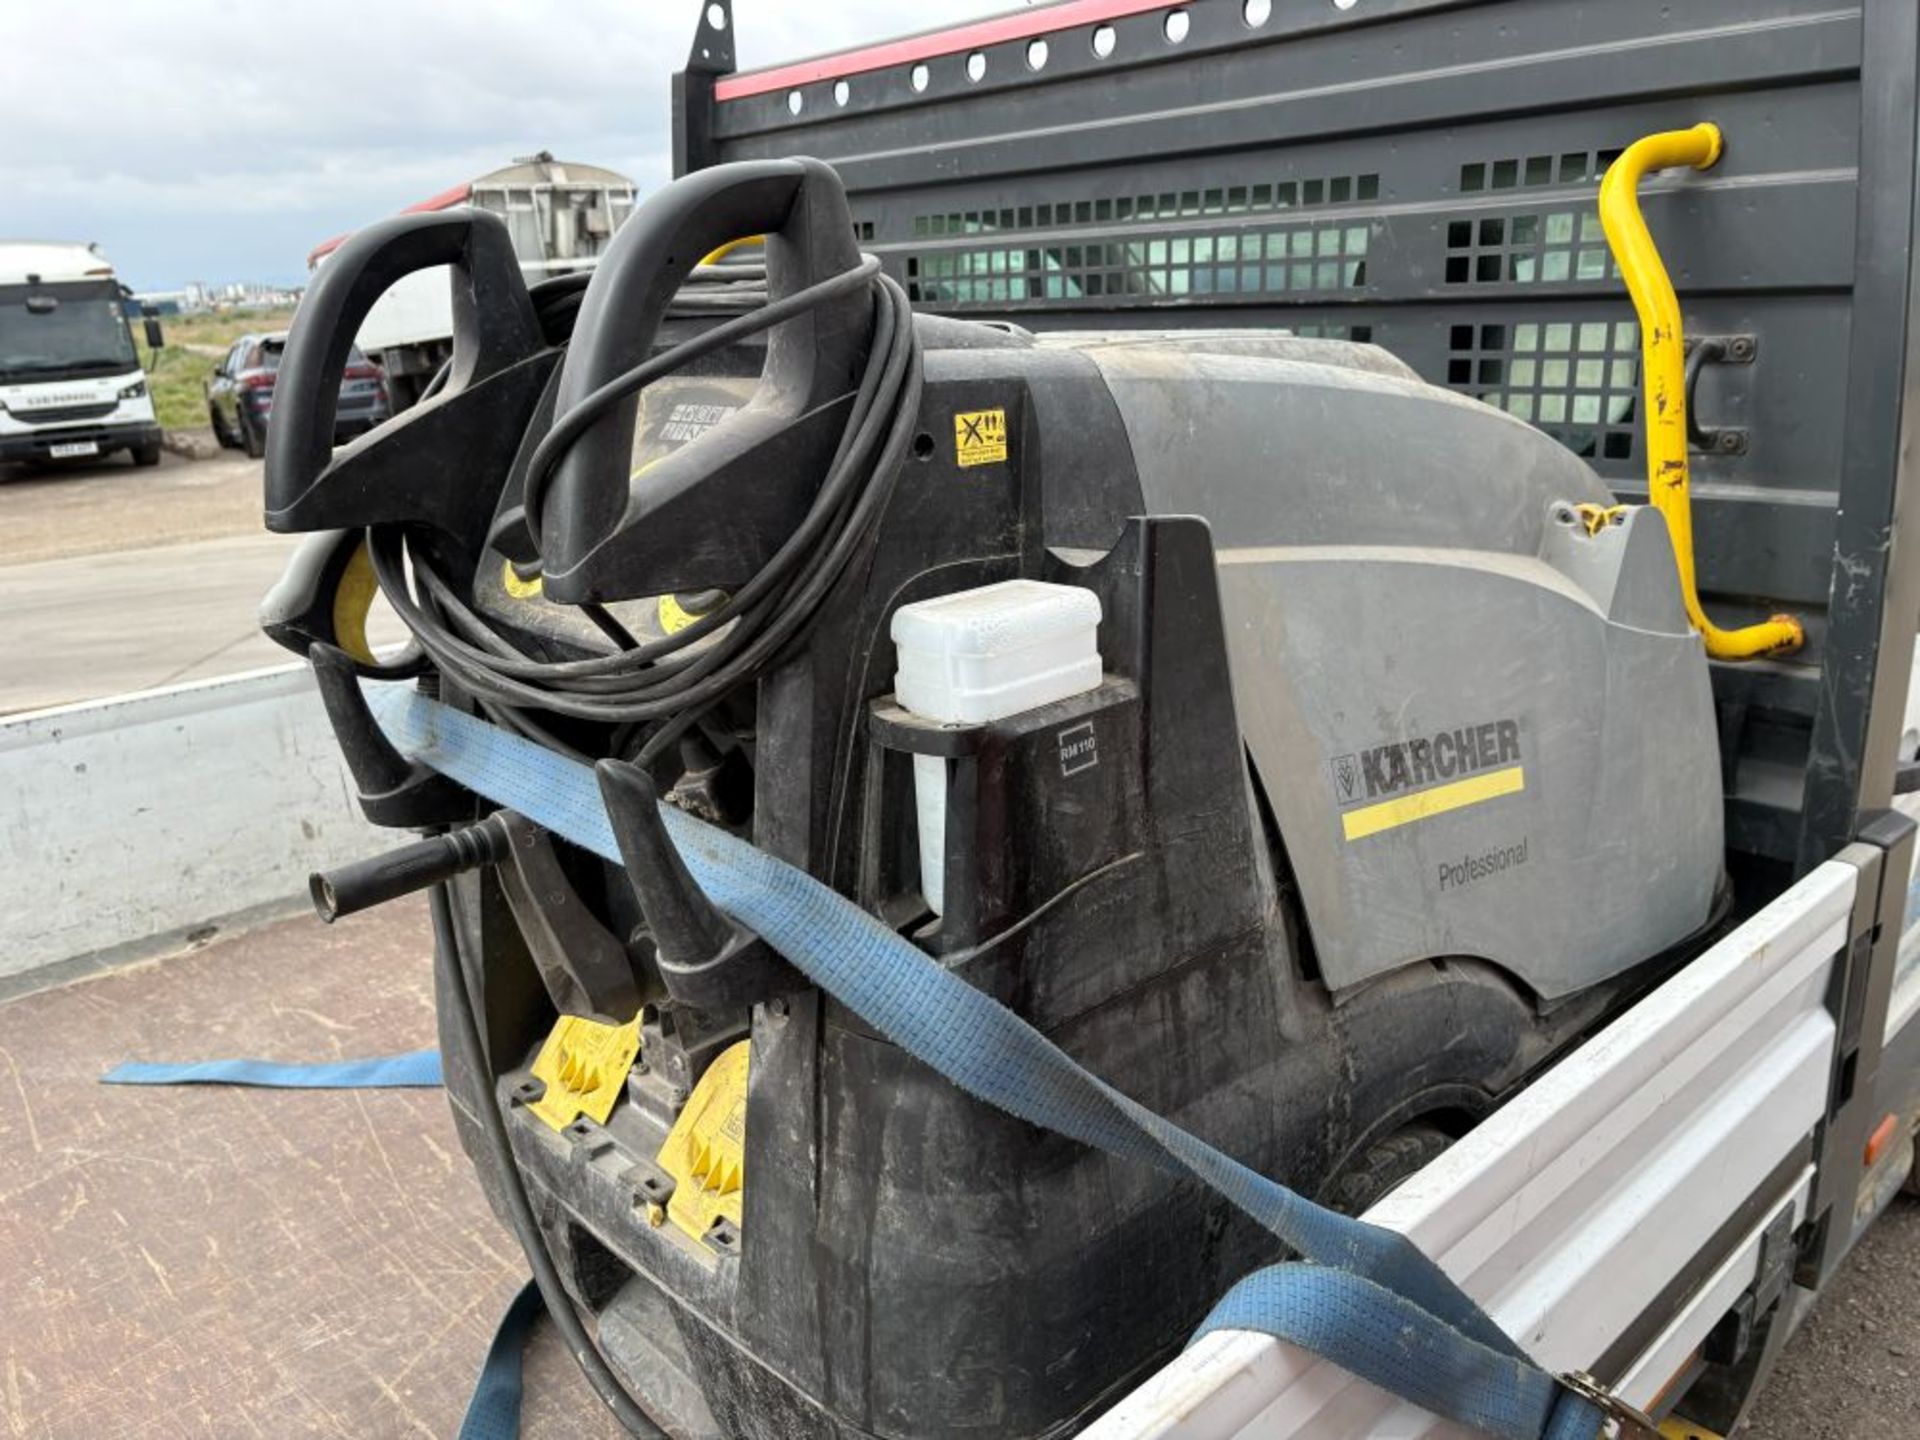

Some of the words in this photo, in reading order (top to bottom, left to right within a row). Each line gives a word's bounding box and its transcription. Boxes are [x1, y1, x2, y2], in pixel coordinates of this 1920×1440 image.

[1060, 743, 1078, 761] RM
[1078, 737, 1096, 753] 110
[1438, 836, 1528, 891] Professional
